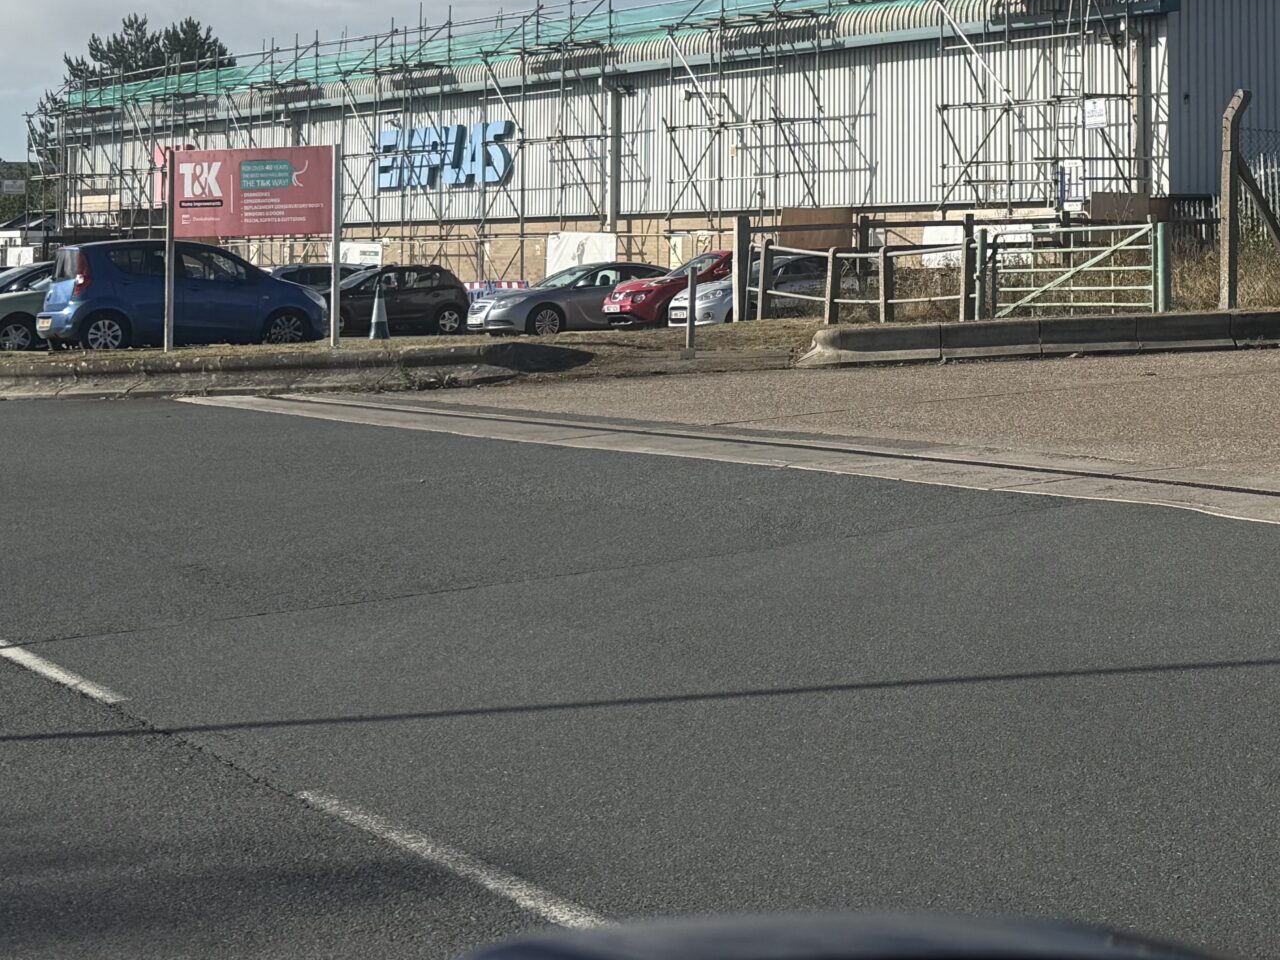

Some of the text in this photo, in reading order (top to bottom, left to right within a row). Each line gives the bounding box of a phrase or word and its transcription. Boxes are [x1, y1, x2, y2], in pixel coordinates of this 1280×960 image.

[376, 120, 513, 189] EMPLAS
[179, 161, 223, 198] T&K
[242, 179, 255, 188] THE
[256, 179, 271, 187] T&K
